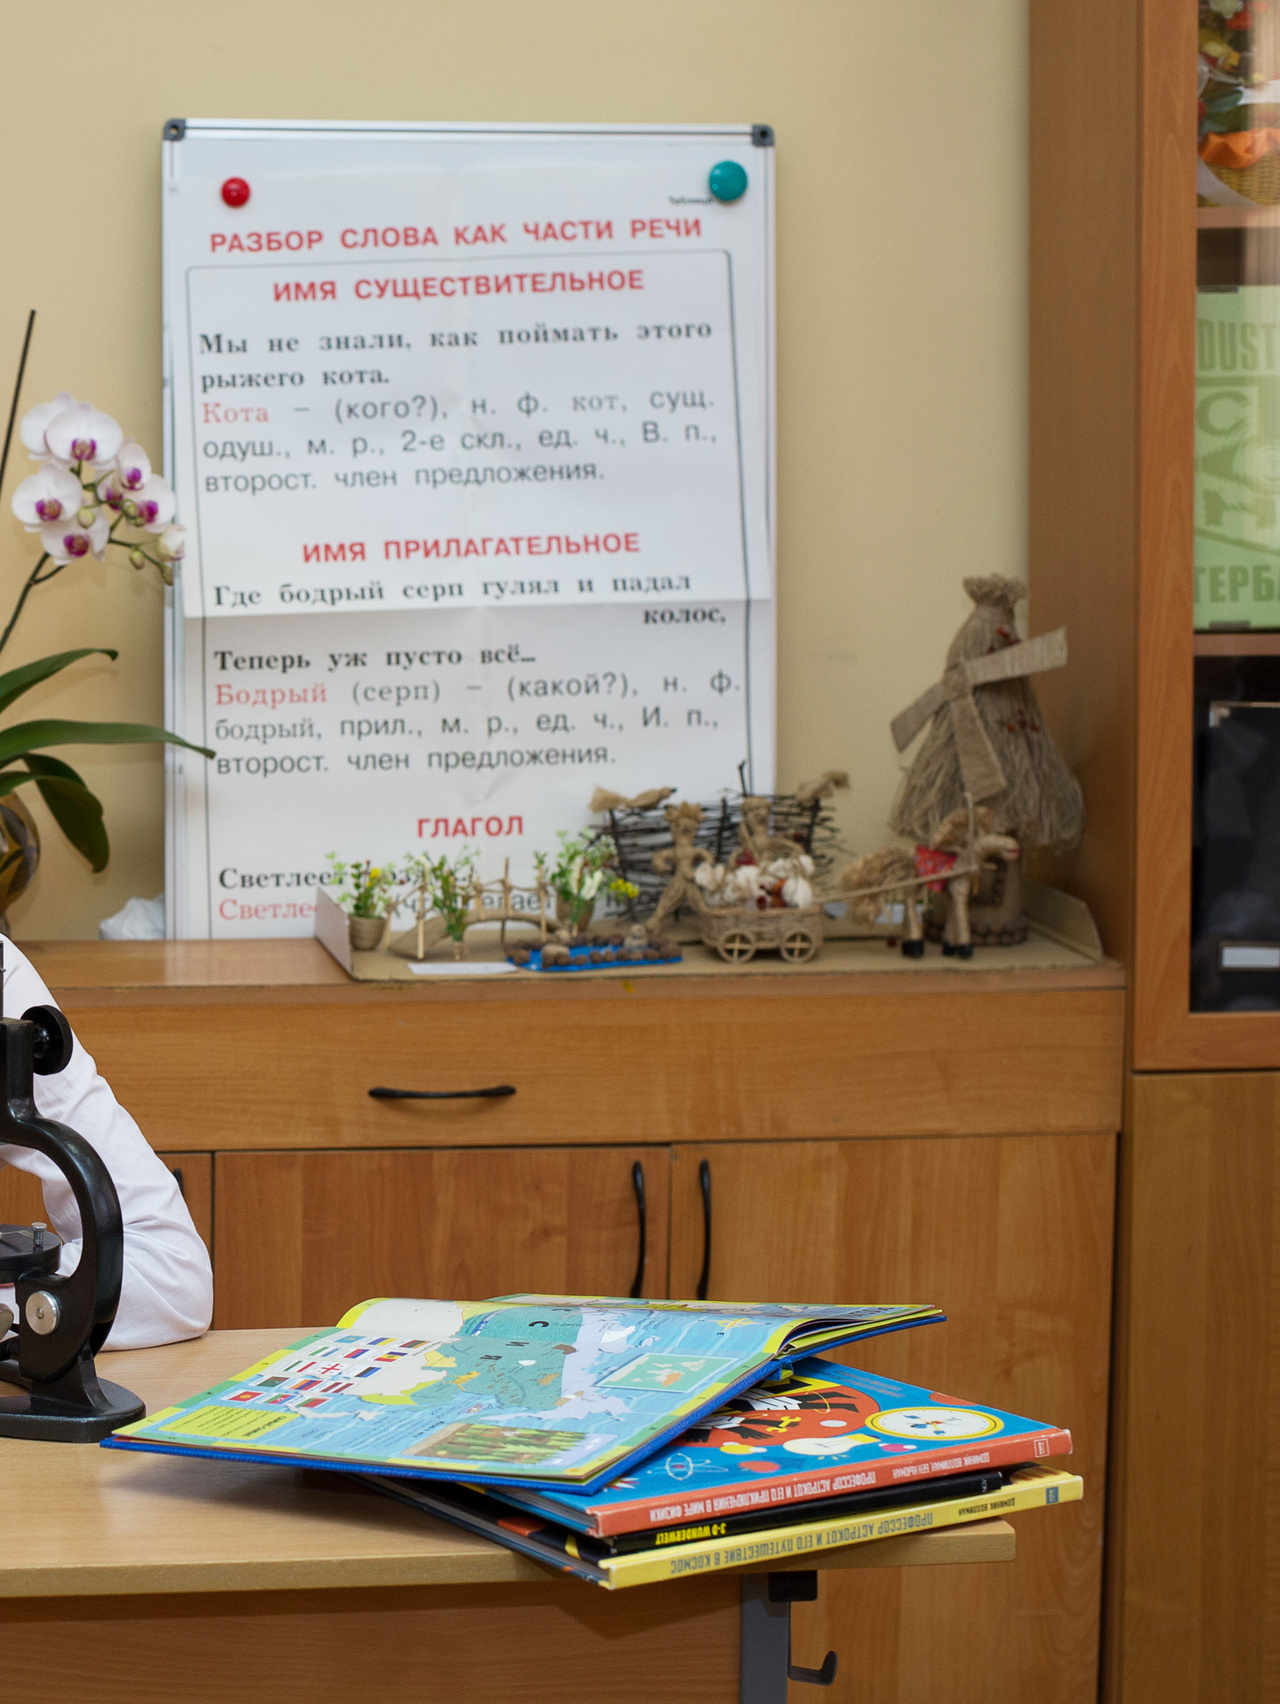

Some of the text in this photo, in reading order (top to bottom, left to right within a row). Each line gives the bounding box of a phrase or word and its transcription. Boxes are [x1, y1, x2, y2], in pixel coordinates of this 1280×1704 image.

[211, 218, 701, 252] РАЗБОР СЛОВА КАК ЧАСТИ РЕЧИ
[274, 270, 643, 301] ИМЯ СУЩЕСТВИТЕЛЬНОЕ
[200, 324, 712, 354] Мы не знали, как поймать этого
[201, 370, 389, 394] рыжего кота.
[203, 403, 268, 423] Кота
[335, 394, 447, 424] (кого?),
[472, 399, 496, 414] н.
[573, 394, 628, 414] кот,
[650, 391, 714, 412] сущ.
[203, 421, 716, 462] одуш., м. р., 2-е скл., ед. ч., В. п.,
[205, 463, 604, 496] второст. член предложения.
[303, 533, 640, 563] ИМЯ ПРИЛАГАТЕЛЬНОЕ
[215, 576, 690, 606] Где бодрый серп гулял и падал
[644, 607, 727, 627] колос,
[214, 651, 310, 673] Теперь
[328, 653, 367, 672] уж
[386, 651, 462, 670] пусто
[216, 684, 326, 710] Бодрый
[352, 680, 440, 707] (серп)
[507, 672, 637, 702] (какой?),
[663, 676, 687, 692] н.
[215, 706, 718, 744] бодрый, прил., м. р., ед. ч., И. п.,
[216, 747, 615, 778] второст. член предложения.
[418, 816, 523, 838] ГЛАГОЛ
[219, 899, 317, 921] Светле
[650, 1471, 876, 1522] ПРОФЕССОР АСТРОКОТ И ЕГО ПРИКЛЮЧЕНИЯ В МИРЕ ФИЗИКИ
[655, 1524, 711, 1545] WUNDERWELT
[671, 1512, 933, 1574] ПРОФЕССОР АСТРОКОТ И ЕГО ПУТЕШЕСТВИЕ В КОСМОС
